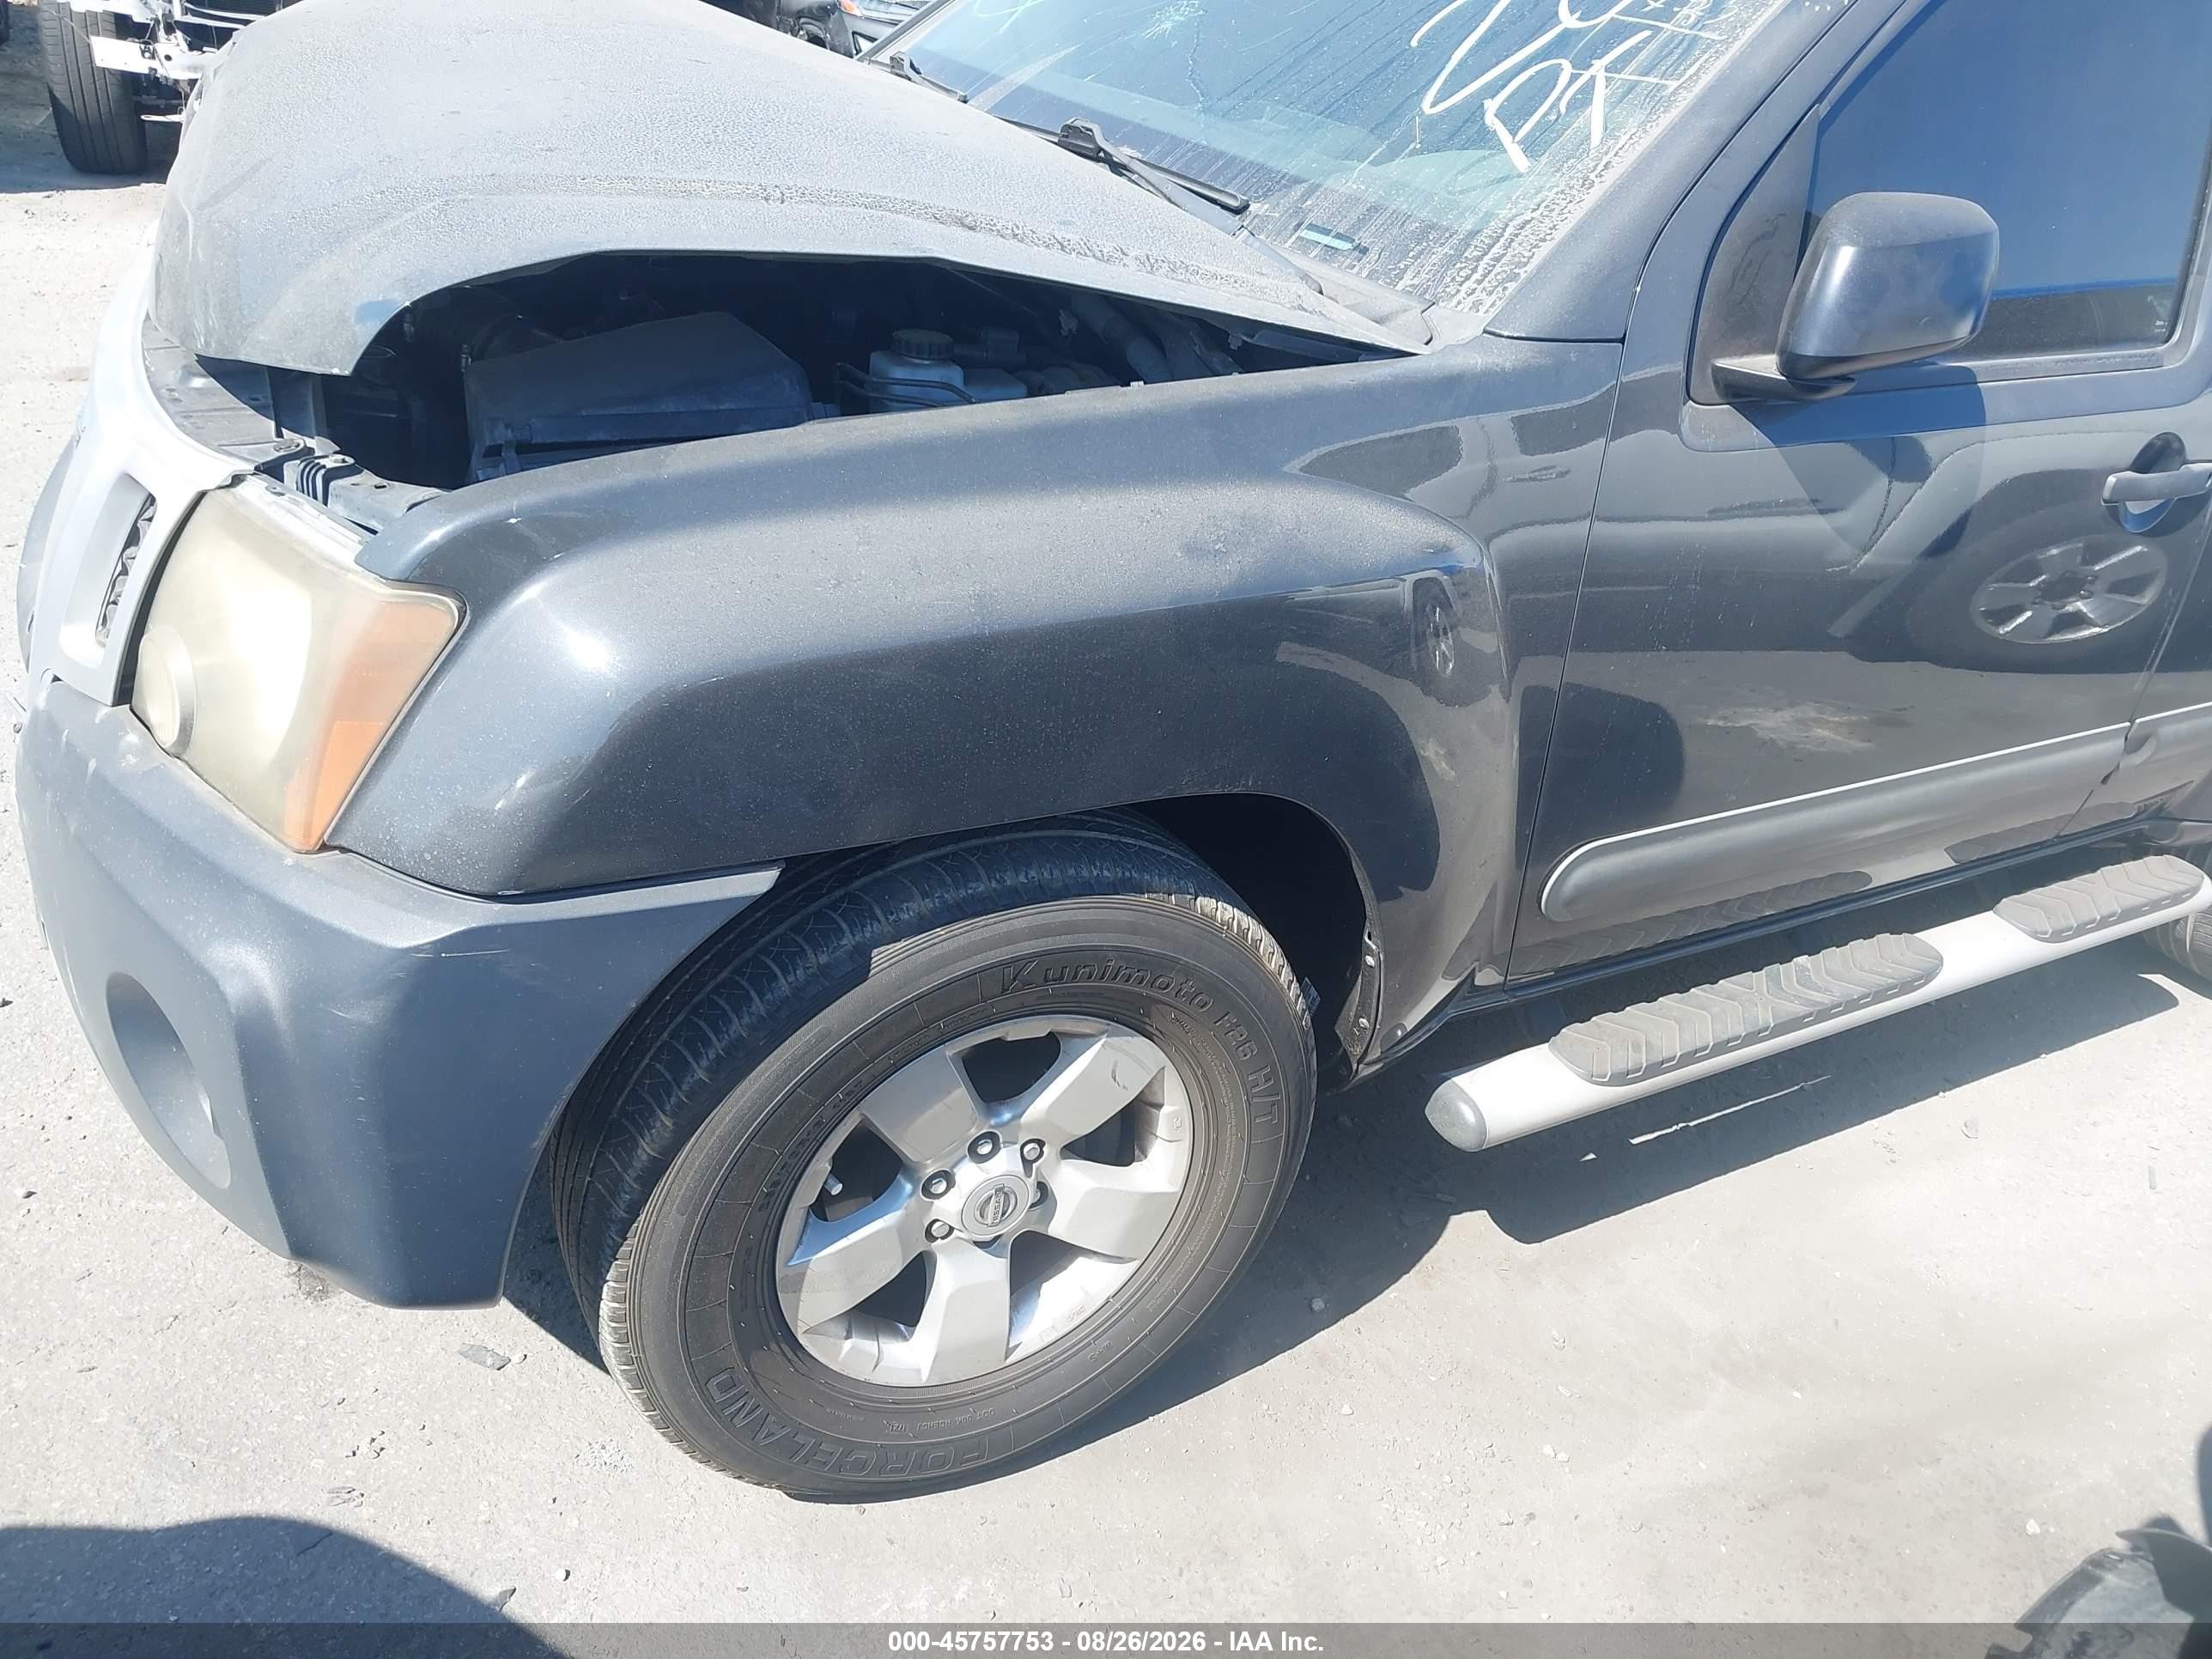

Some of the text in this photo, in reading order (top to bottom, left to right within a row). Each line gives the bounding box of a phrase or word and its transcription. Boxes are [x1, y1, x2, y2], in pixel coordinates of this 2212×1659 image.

[1001, 957, 1282, 1126] Kunimoto F26 H/T
[703, 1365, 989, 1477] FORCELAND
[976, 1407, 995, 1421] DOT
